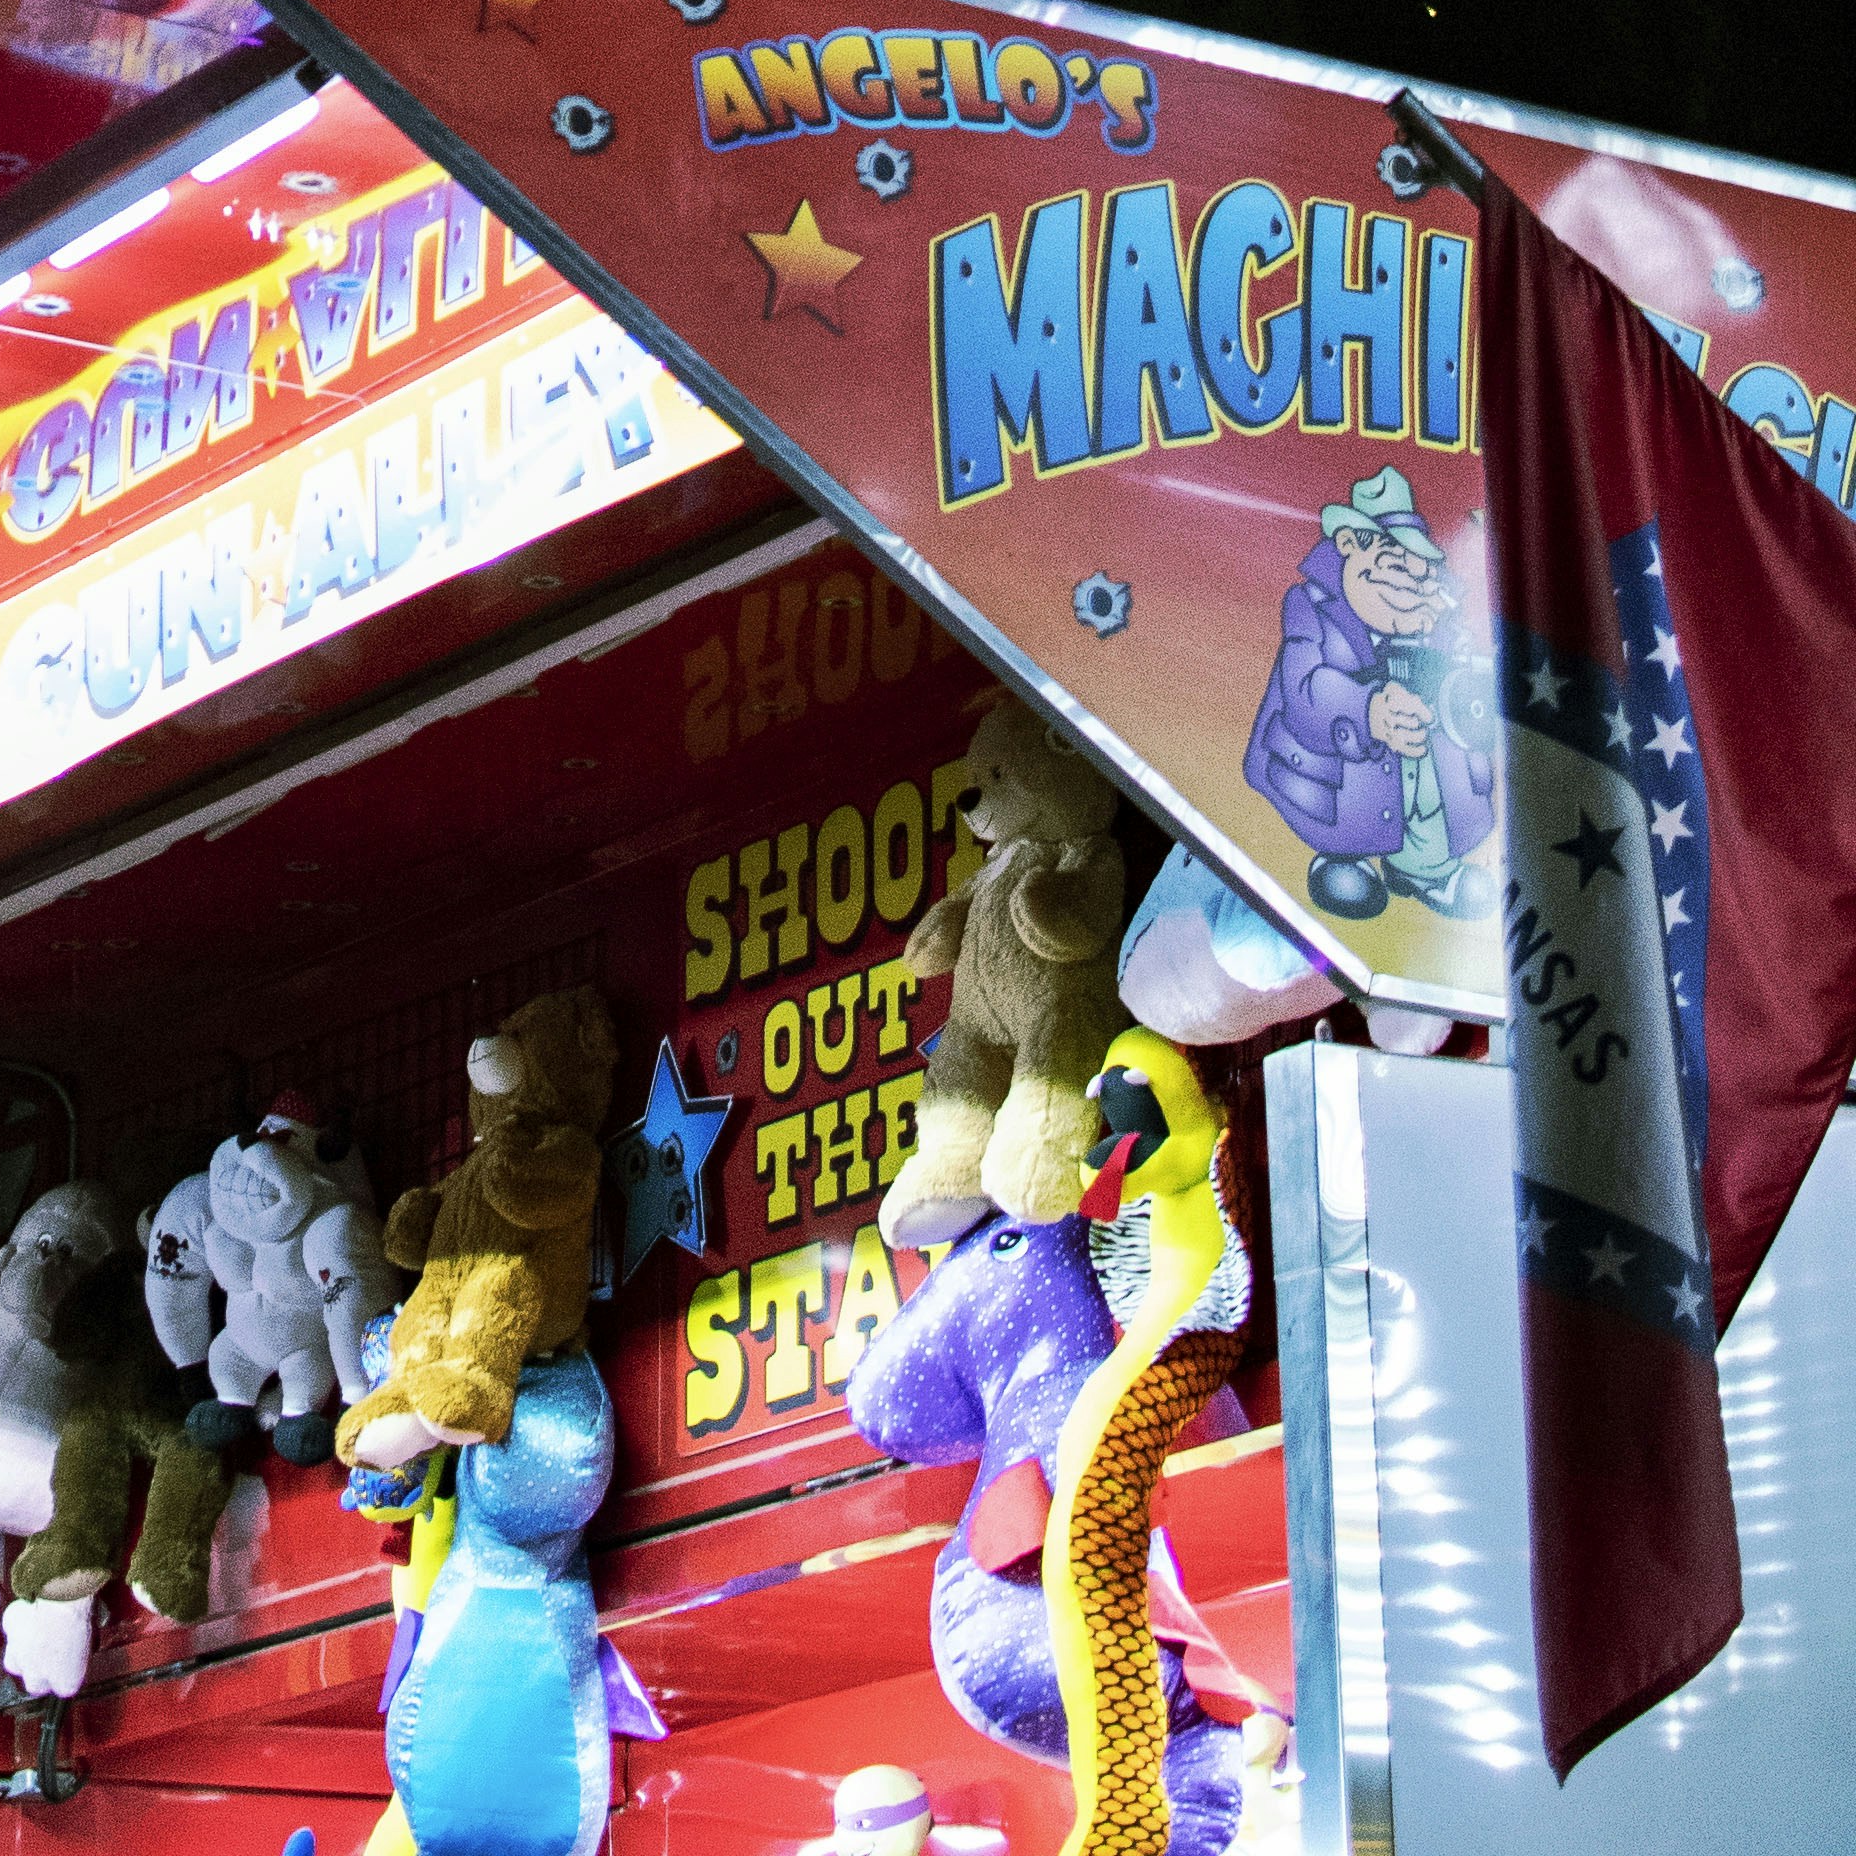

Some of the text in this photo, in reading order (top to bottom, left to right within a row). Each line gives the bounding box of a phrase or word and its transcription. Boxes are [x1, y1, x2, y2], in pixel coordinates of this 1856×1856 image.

[696, 28, 1156, 152] ANGELO'S
[2, 516, 246, 720] GUN
[762, 957, 919, 1096] OUT
[1503, 878, 1630, 1085] NSAS
[755, 1068, 925, 1224] THE
[685, 1223, 954, 1434] STA
